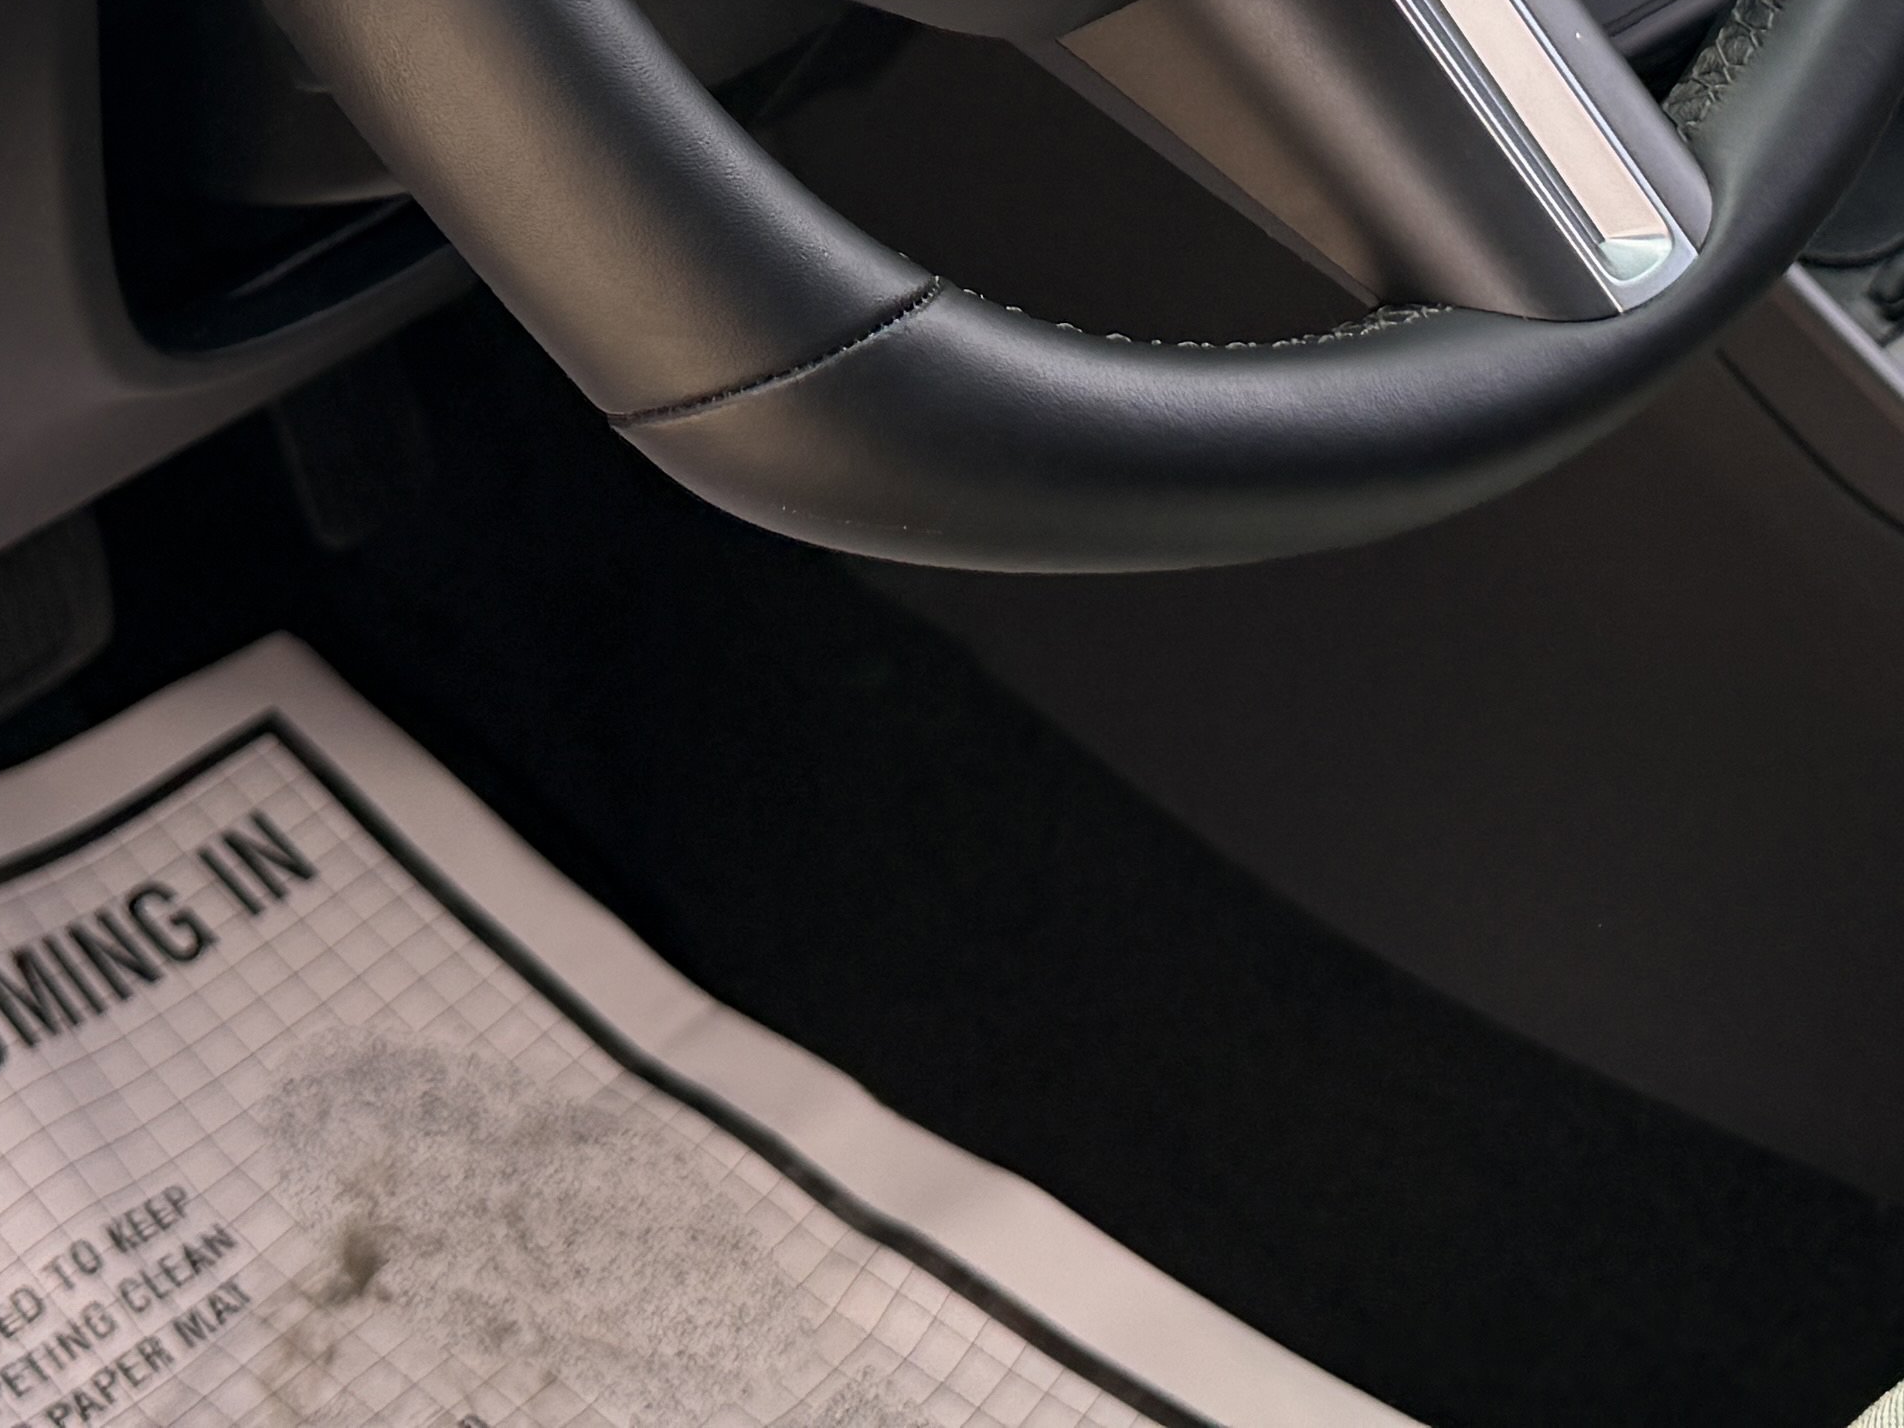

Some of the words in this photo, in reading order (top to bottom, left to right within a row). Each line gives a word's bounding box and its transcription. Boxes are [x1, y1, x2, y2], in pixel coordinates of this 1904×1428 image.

[200, 809, 318, 917] IN
[45, 1237, 104, 1292] TO
[104, 1184, 190, 1256] KEEP
[120, 1222, 239, 1315] CLEAN
[45, 1334, 177, 1428] PAPER
[173, 1275, 253, 1348] MAT
